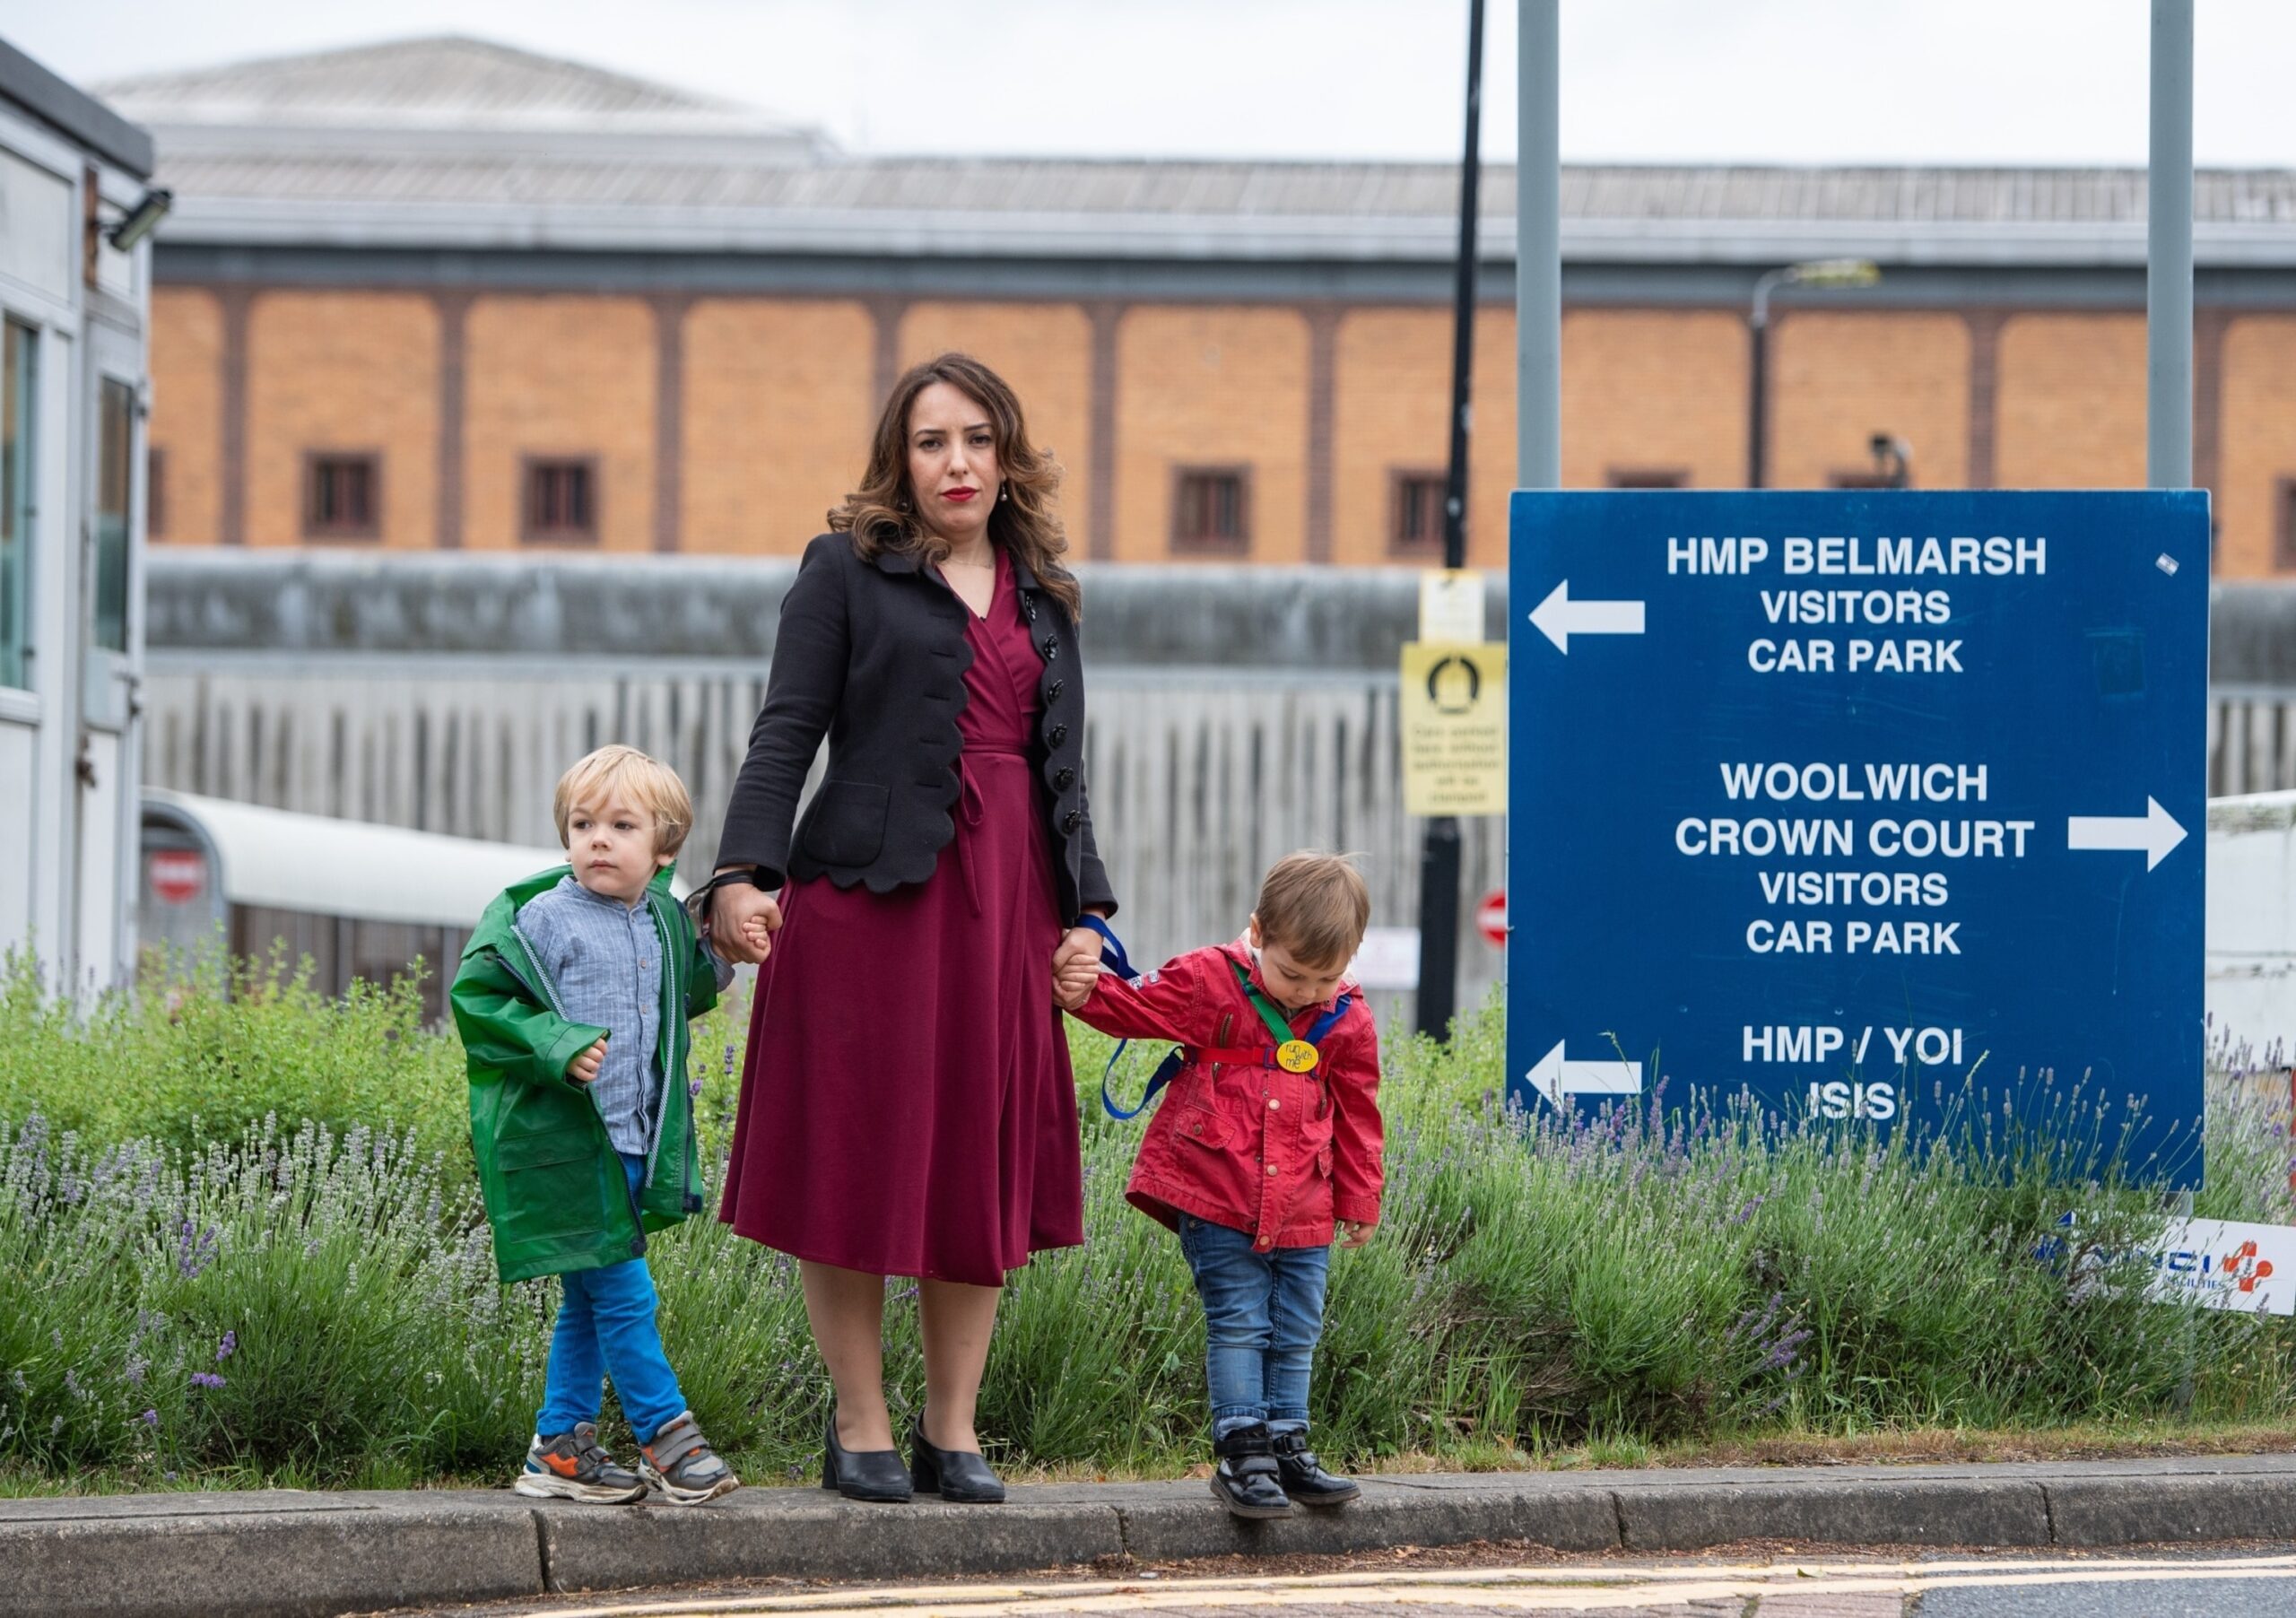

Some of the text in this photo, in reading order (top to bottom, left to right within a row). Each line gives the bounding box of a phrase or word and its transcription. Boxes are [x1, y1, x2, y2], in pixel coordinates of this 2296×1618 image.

[1667, 536, 2047, 575] HMP BELMARSH
[1761, 589, 1951, 624] VISITORS
[1748, 639, 1964, 673] CAR PARK
[1720, 762, 1988, 801] WOOLWICH
[1675, 817, 2036, 857] CROWN COURT
[1759, 871, 1949, 906] VISITORS
[1746, 919, 1961, 954] CAR PARK
[1285, 1044, 1300, 1053] run
[1295, 1049, 1313, 1060] with
[1743, 1025, 1962, 1065] HMP / YOI
[1285, 1058, 1300, 1069] me
[1809, 1081, 1895, 1120] ISIS
